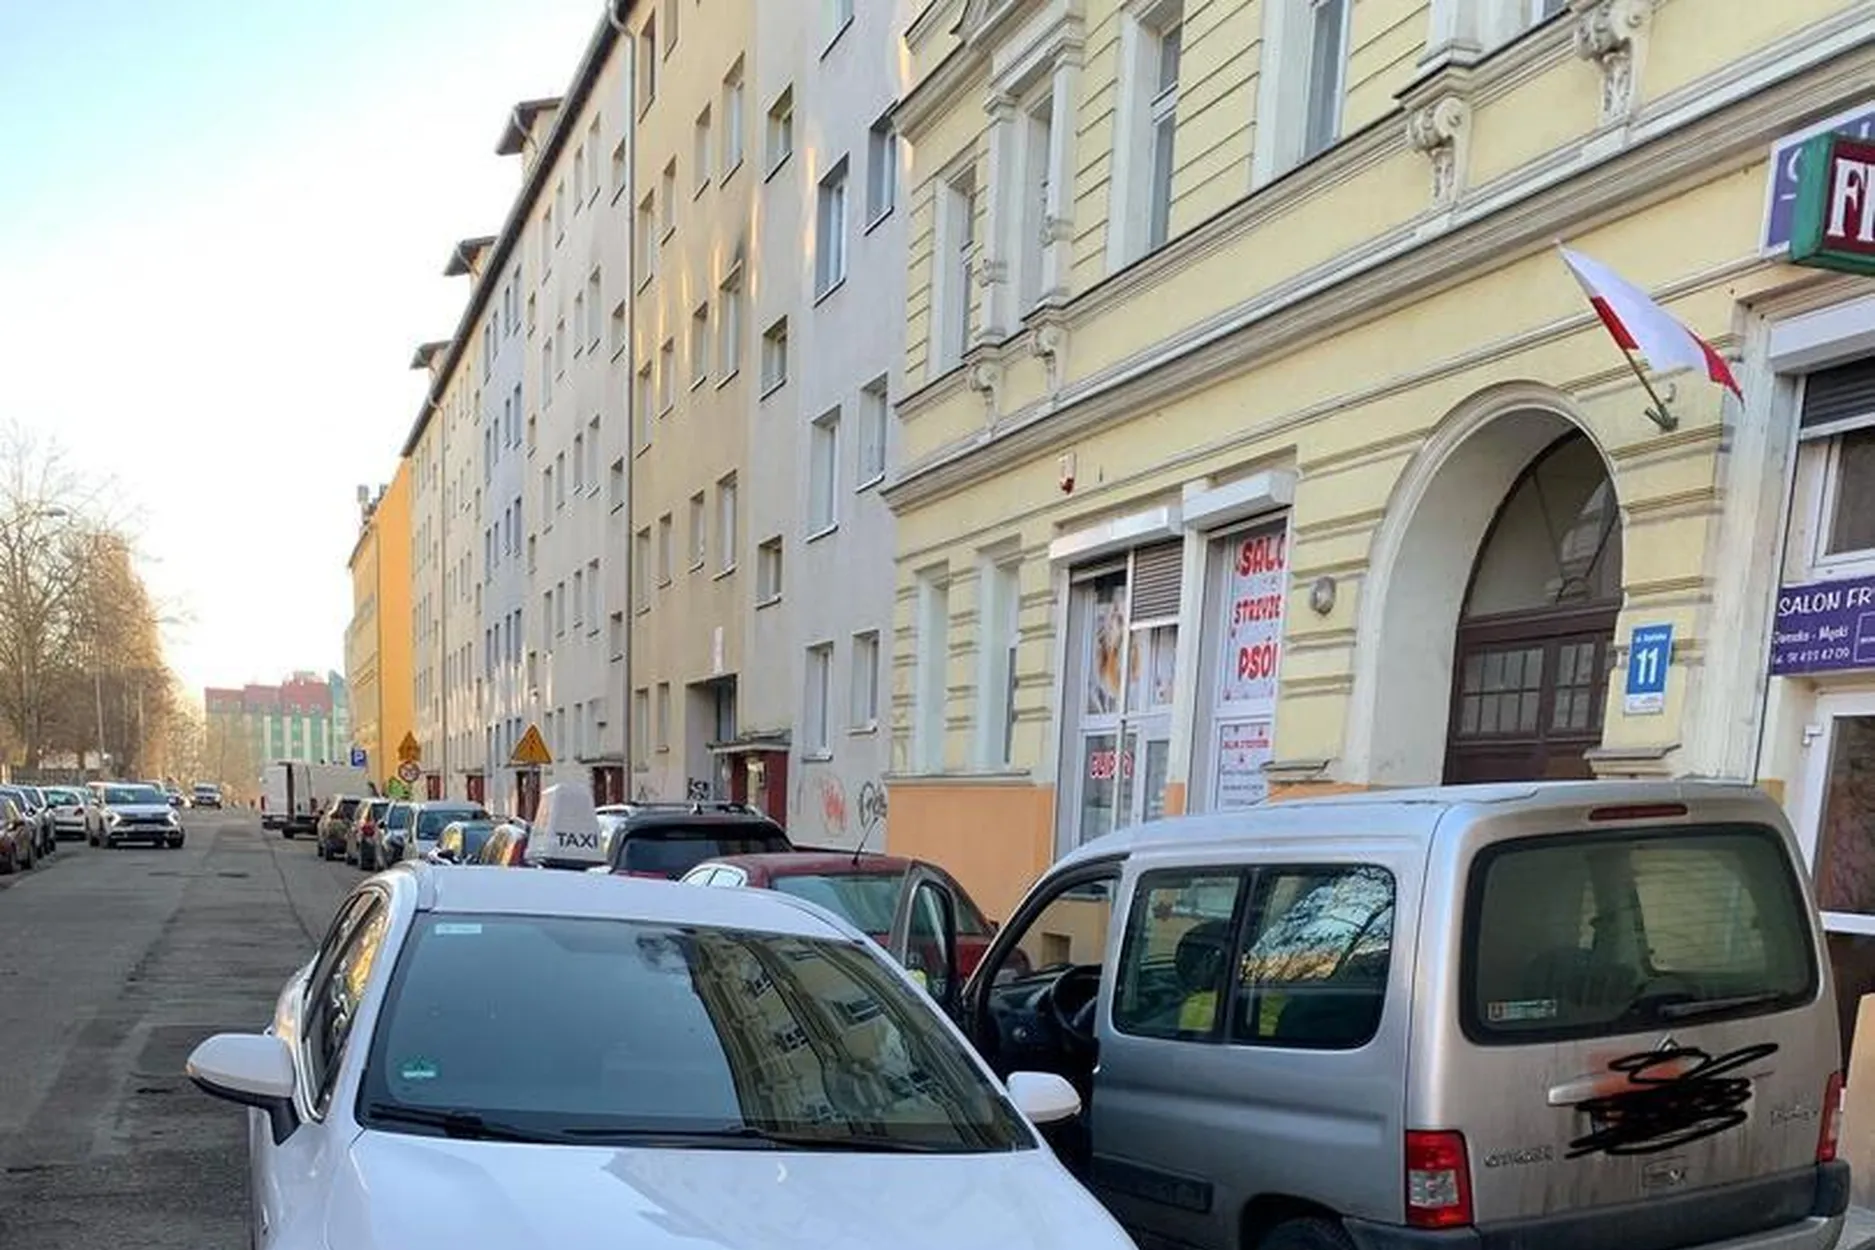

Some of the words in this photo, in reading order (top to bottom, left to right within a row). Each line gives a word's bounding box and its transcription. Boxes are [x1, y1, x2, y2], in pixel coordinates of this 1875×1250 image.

[1778, 591, 1841, 616] SALON
[1846, 587, 1875, 608] FR
[1637, 648, 1658, 684] 11
[556, 832, 598, 849] TAXI
